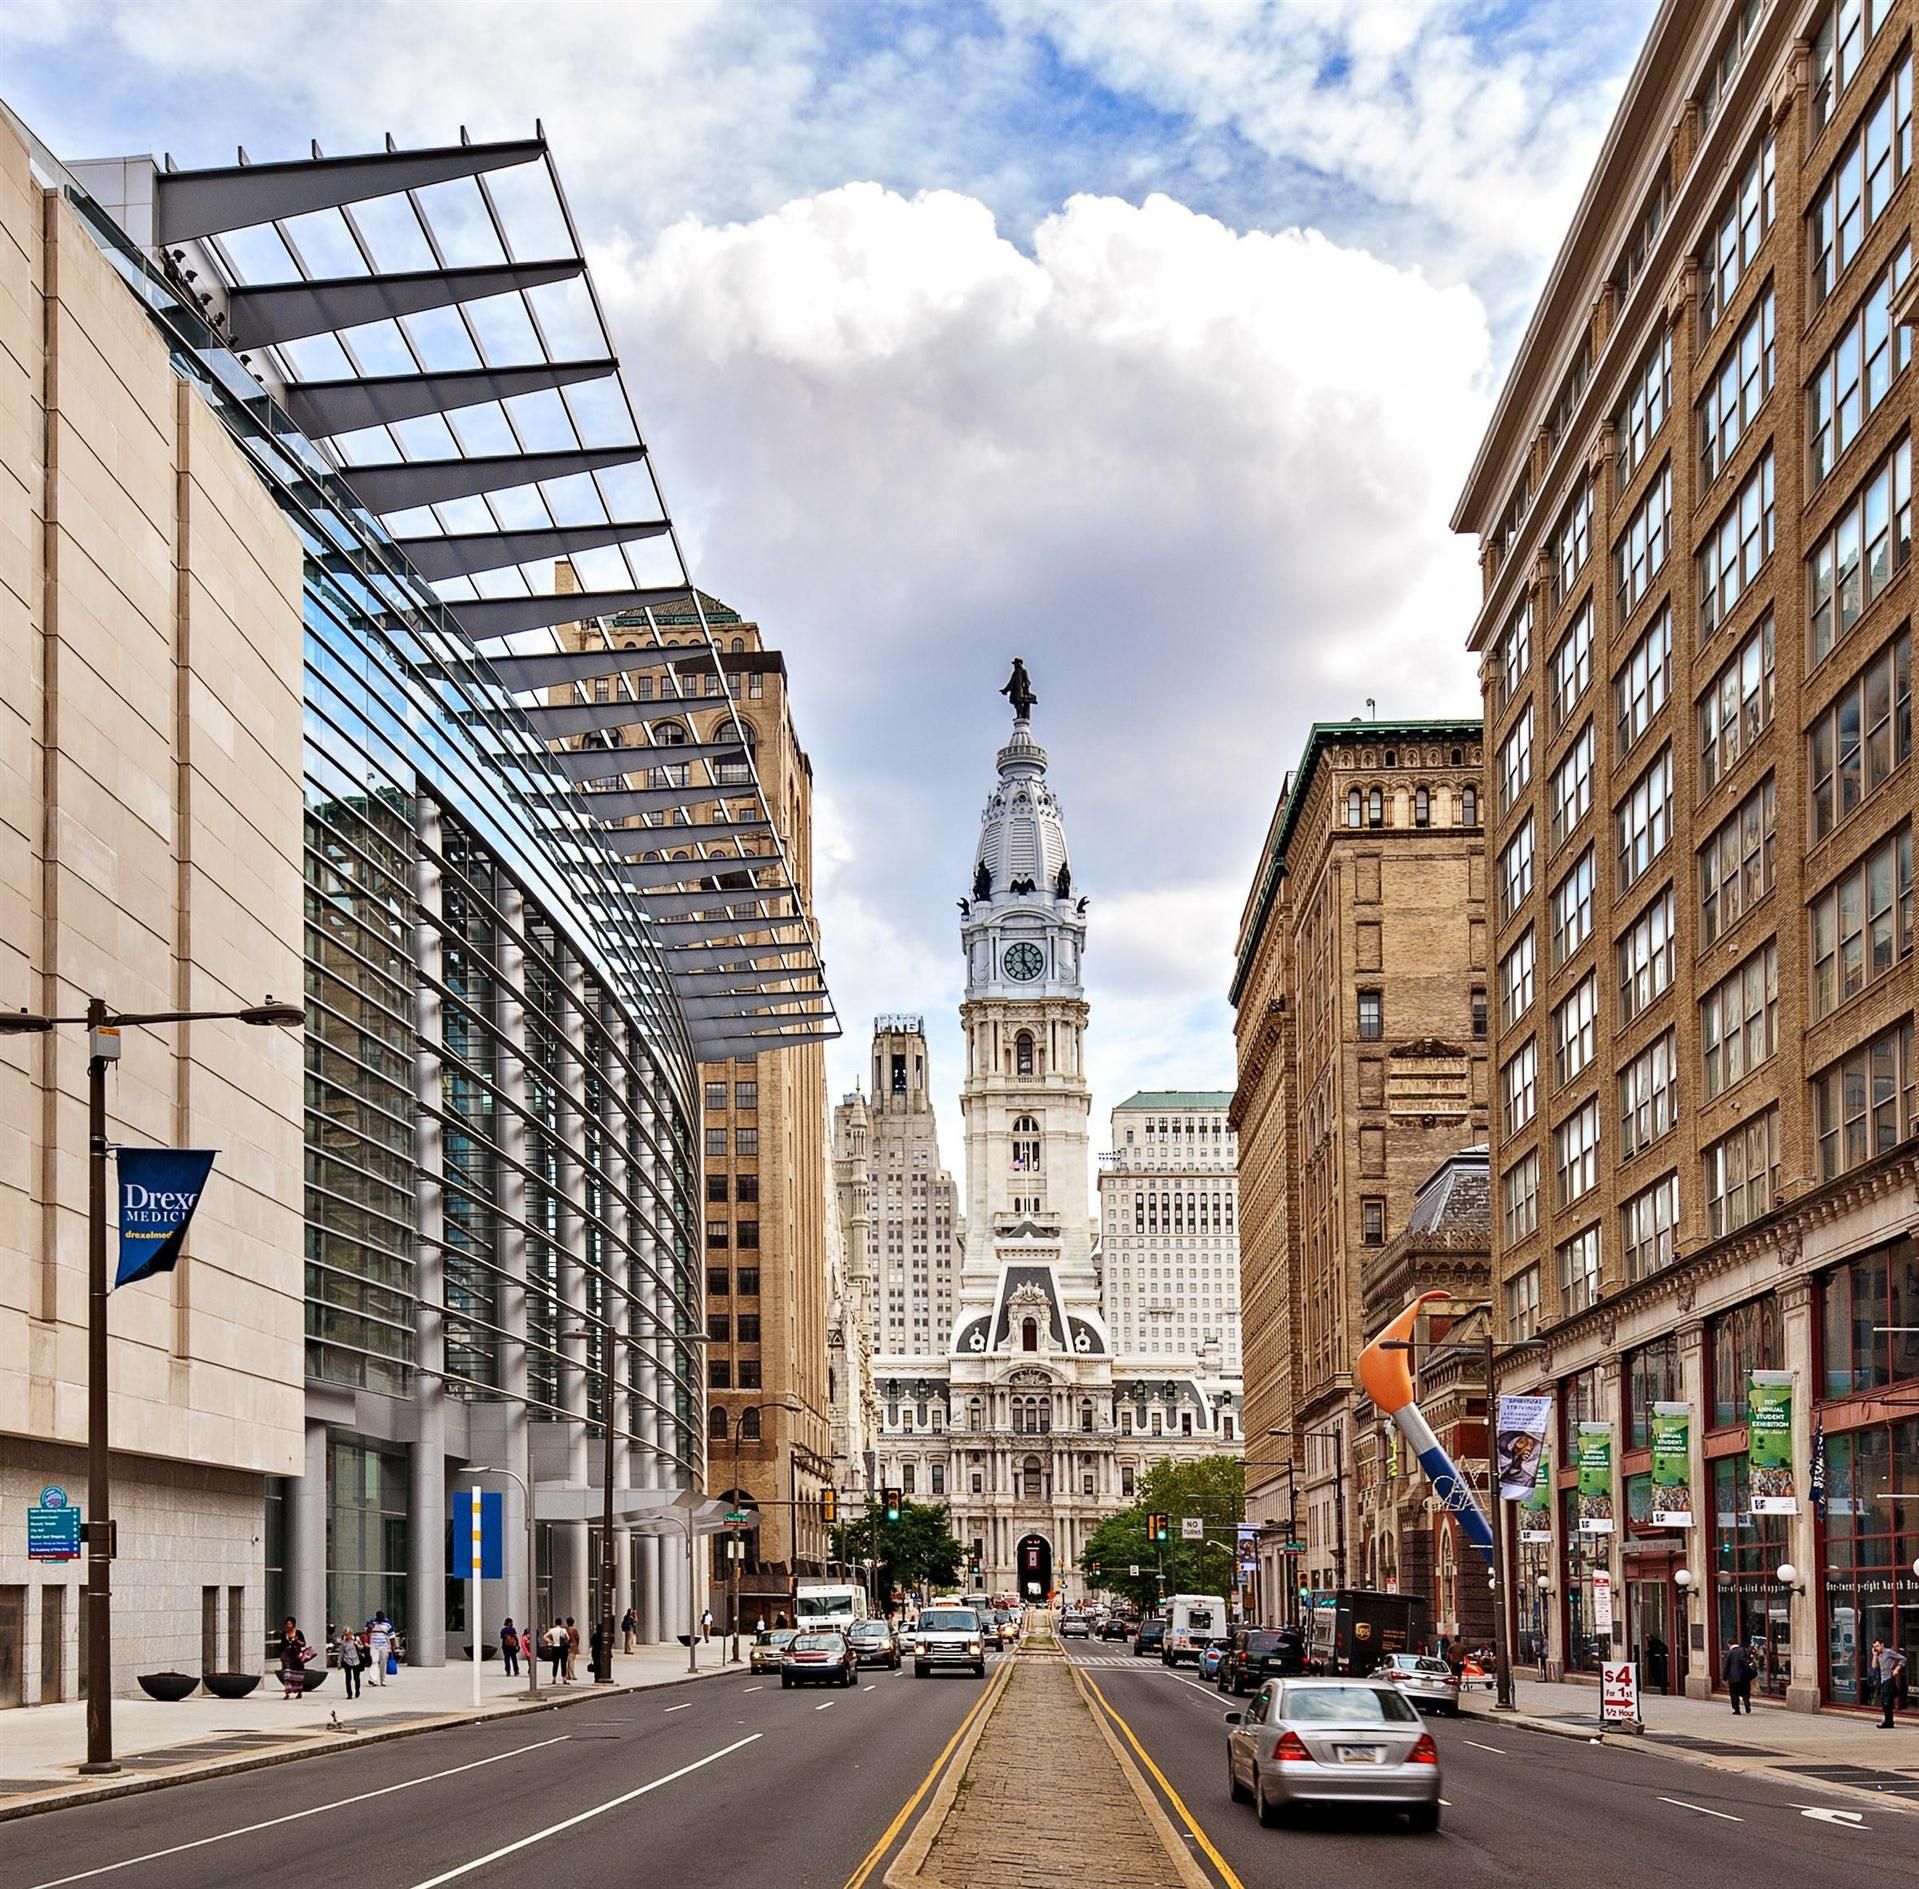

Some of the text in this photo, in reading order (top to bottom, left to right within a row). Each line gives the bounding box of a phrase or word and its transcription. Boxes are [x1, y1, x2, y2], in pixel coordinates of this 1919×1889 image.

[1606, 1686, 1633, 1698] For 1st
[1618, 1709, 1635, 1717] Hour
